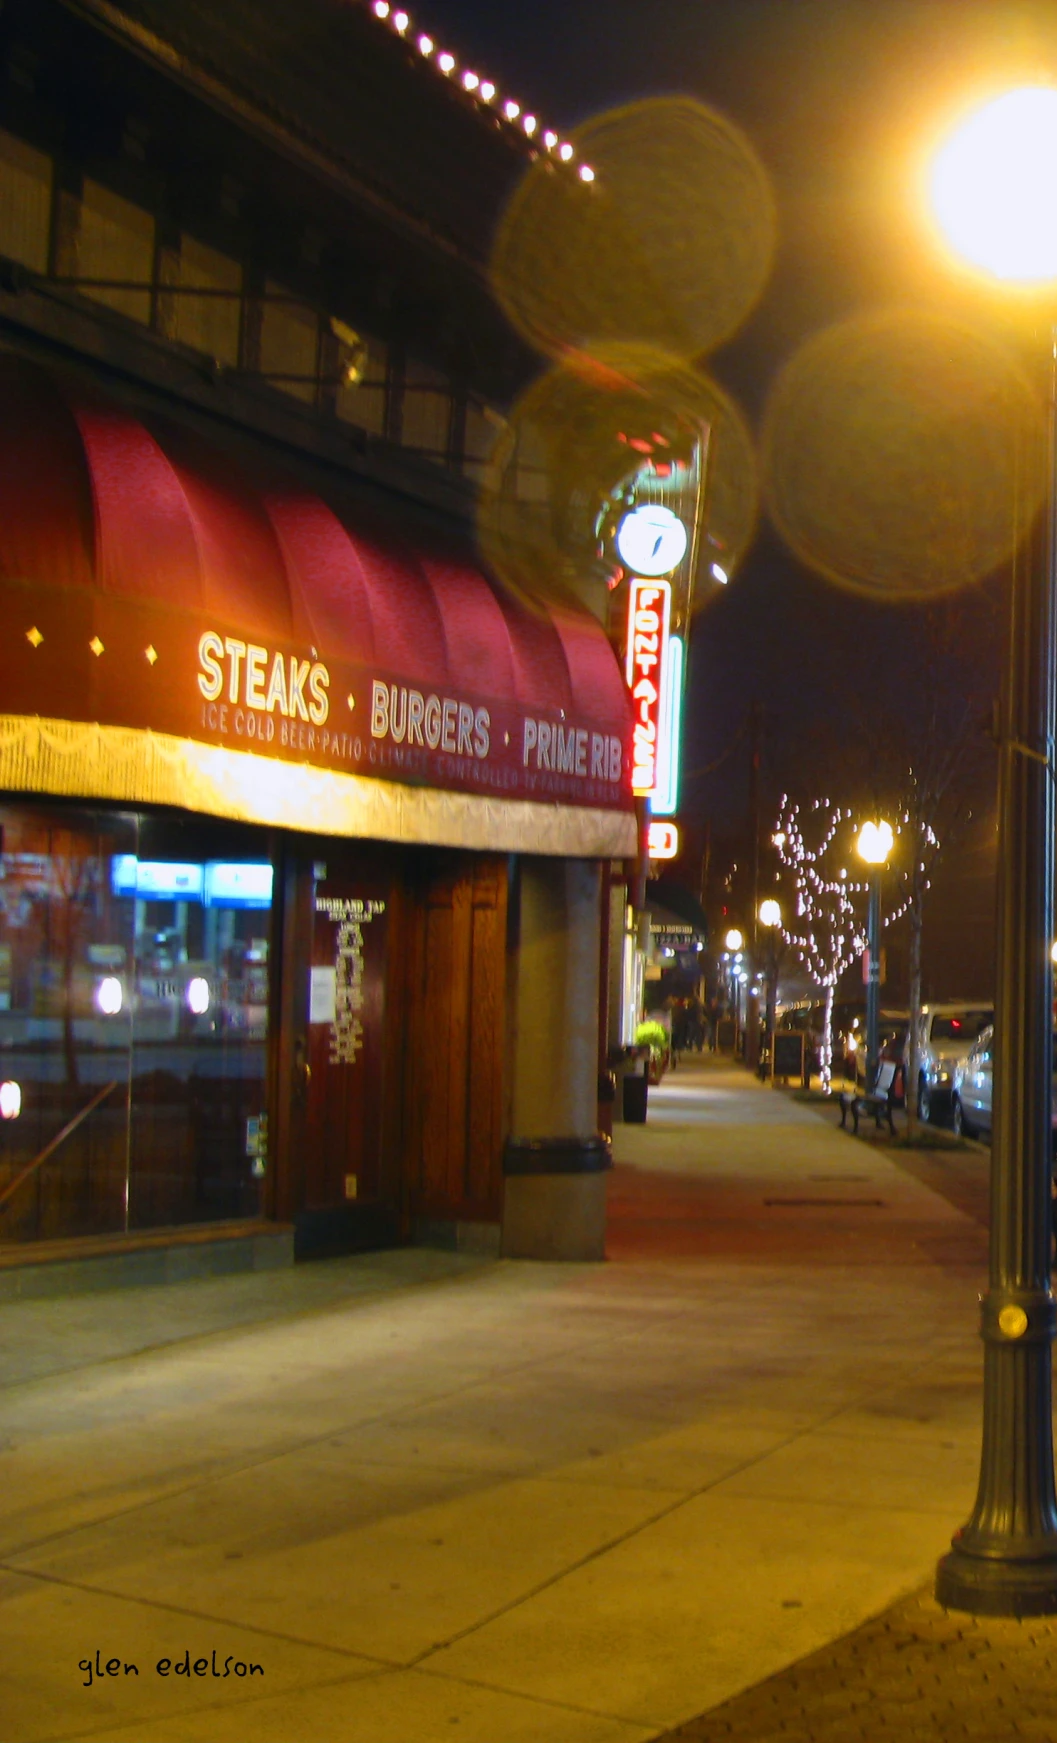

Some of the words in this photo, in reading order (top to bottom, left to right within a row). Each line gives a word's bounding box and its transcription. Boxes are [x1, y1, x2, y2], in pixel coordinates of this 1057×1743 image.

[198, 631, 330, 726] STEAKS
[371, 679, 491, 759] BURGERS
[523, 716, 588, 777] PRIME
[591, 731, 622, 783] RIB
[202, 703, 228, 733] ICE
[234, 708, 275, 742] COLD
[281, 719, 315, 752] BEER
[322, 728, 361, 761] PATIO
[316, 897, 363, 913] HIGHLAND
[367, 899, 385, 914] TAP
